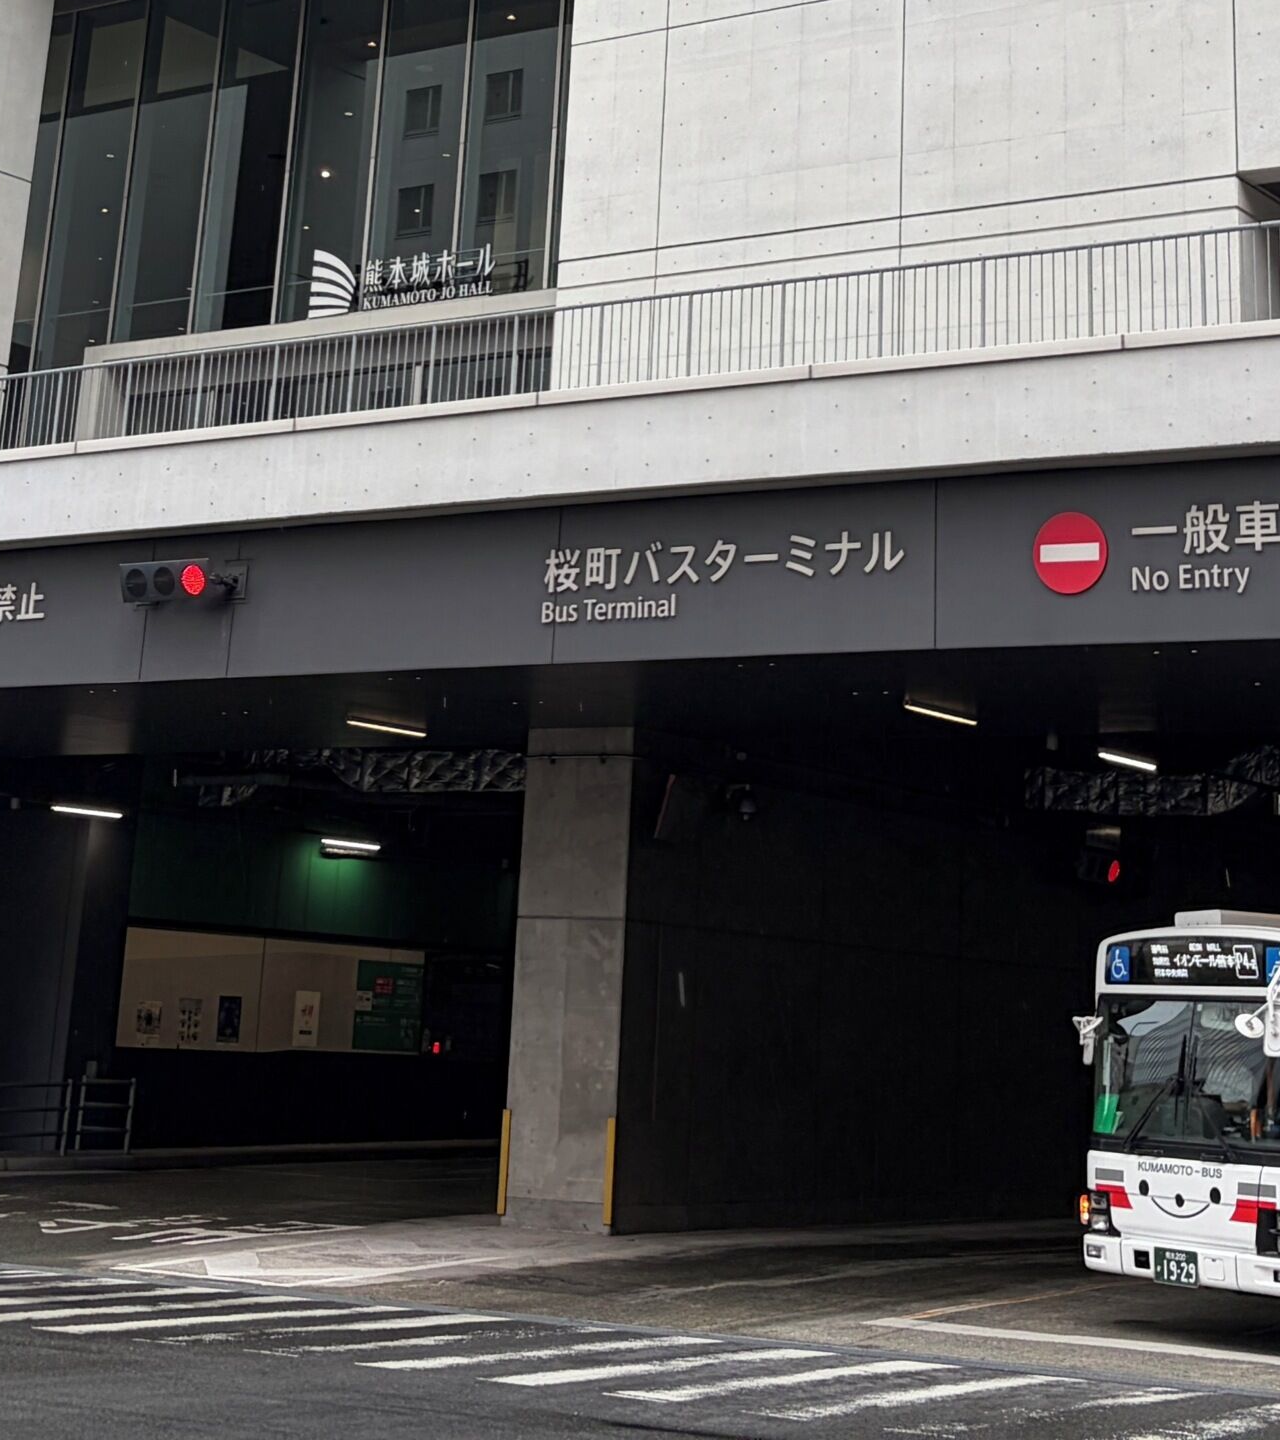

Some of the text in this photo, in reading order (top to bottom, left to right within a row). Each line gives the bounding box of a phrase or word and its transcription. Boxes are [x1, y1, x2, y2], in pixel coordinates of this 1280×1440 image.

[363, 242, 497, 295] 熊本城ホール
[362, 279, 494, 311] KUMAMOTO-JO HALL
[543, 530, 906, 594] 桜町バスターミナル
[1131, 563, 1251, 595] No Entry
[540, 593, 677, 625] Bus Terminal
